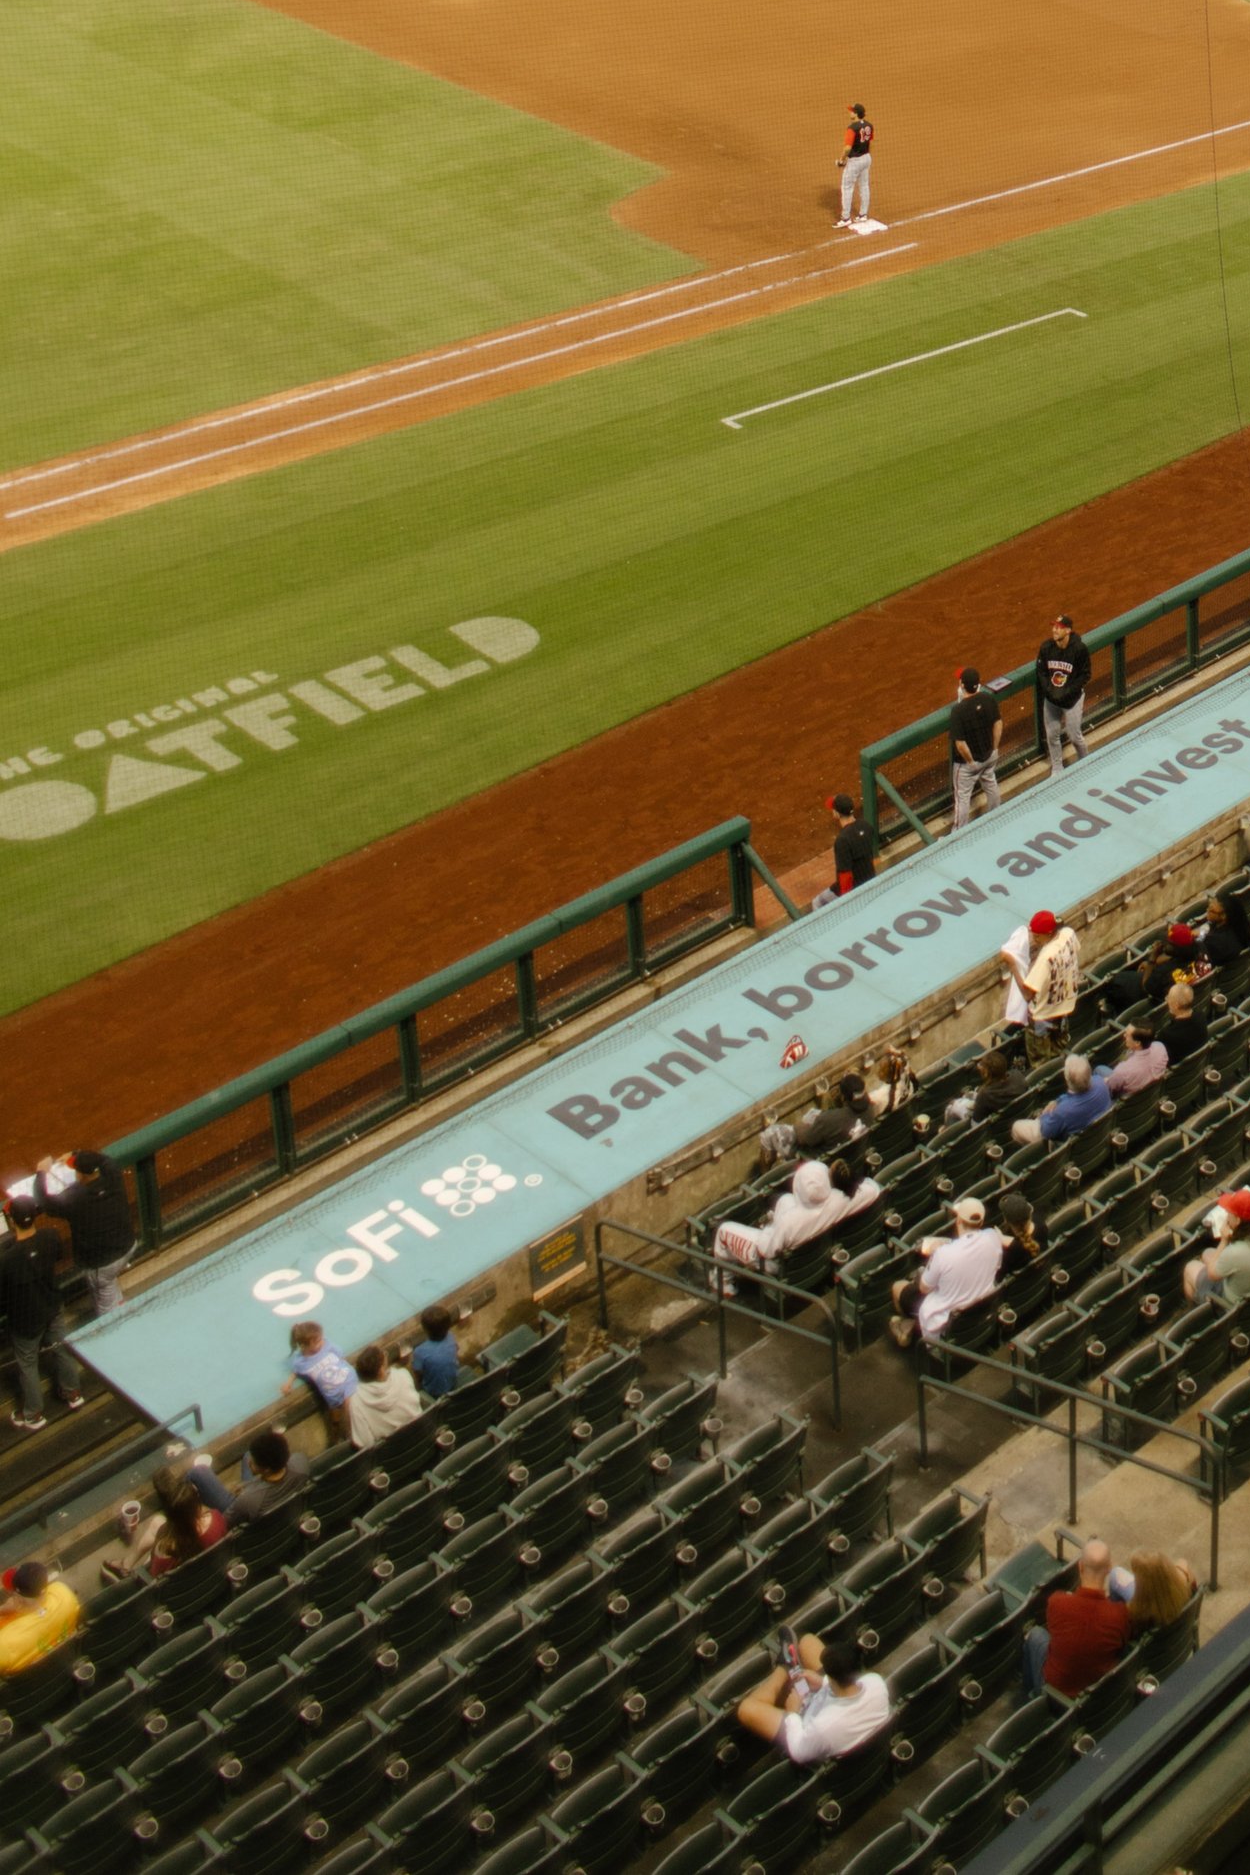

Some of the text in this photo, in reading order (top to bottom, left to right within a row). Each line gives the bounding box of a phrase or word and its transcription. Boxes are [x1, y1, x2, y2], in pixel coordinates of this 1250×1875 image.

[73, 669, 280, 750] ORIGINAL
[545, 1022, 770, 1141] Bank,
[742, 876, 1011, 1022] borrow,
[996, 802, 1112, 878] and
[252, 1198, 441, 1318] SoFi
